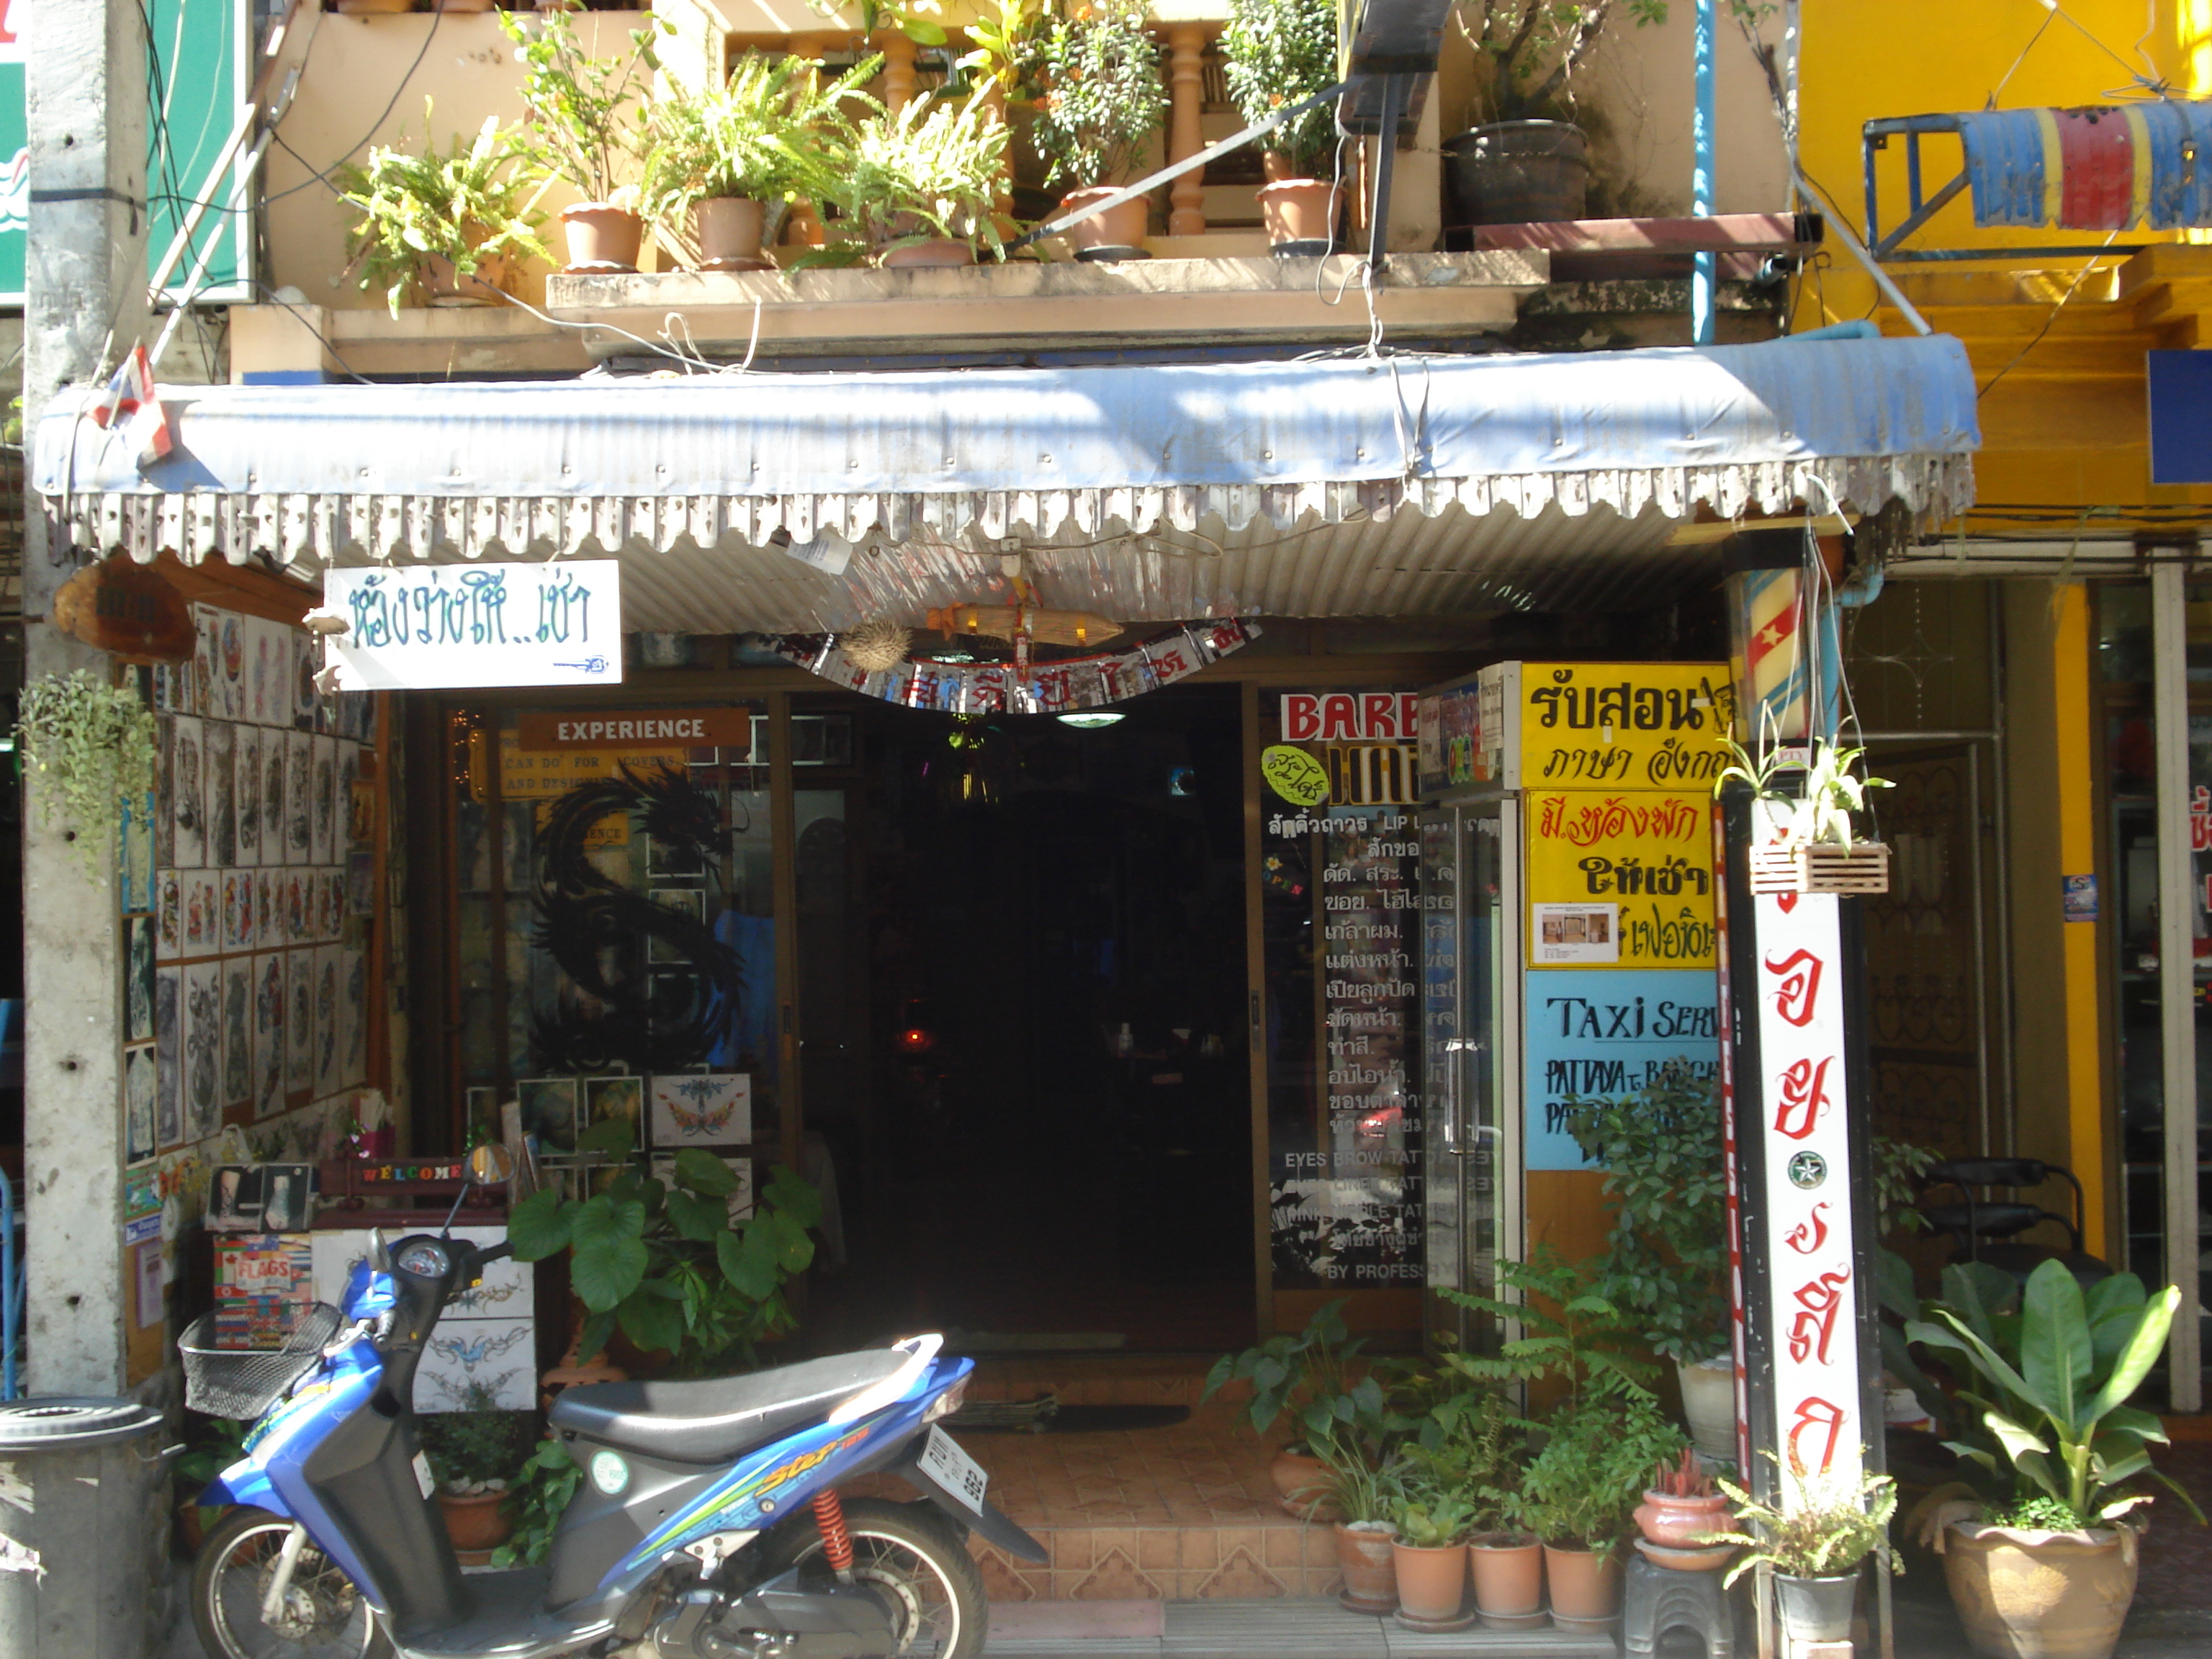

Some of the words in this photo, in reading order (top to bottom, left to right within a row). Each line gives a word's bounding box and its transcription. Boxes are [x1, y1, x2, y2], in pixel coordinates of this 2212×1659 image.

[1531, 669, 1704, 730] รับสอน
[558, 719, 705, 741] EXPERIENCE
[505, 757, 534, 768] CAN
[542, 757, 560, 768] DO
[574, 757, 599, 768] FOR
[624, 755, 674, 767] COVERS
[1543, 747, 1634, 781] ภาษา
[506, 778, 535, 789] AND
[1384, 815, 1408, 830] LIP
[1578, 855, 1709, 896] ให้เช่า
[1329, 1087, 1422, 1109] ขอบตาล่า
[1285, 1152, 1327, 1168] EYES
[1334, 1151, 1382, 1166] BROW
[362, 1164, 462, 1182] WELCOME
[238, 1259, 289, 1280] FLAGS
[1328, 1265, 1349, 1280] BY
